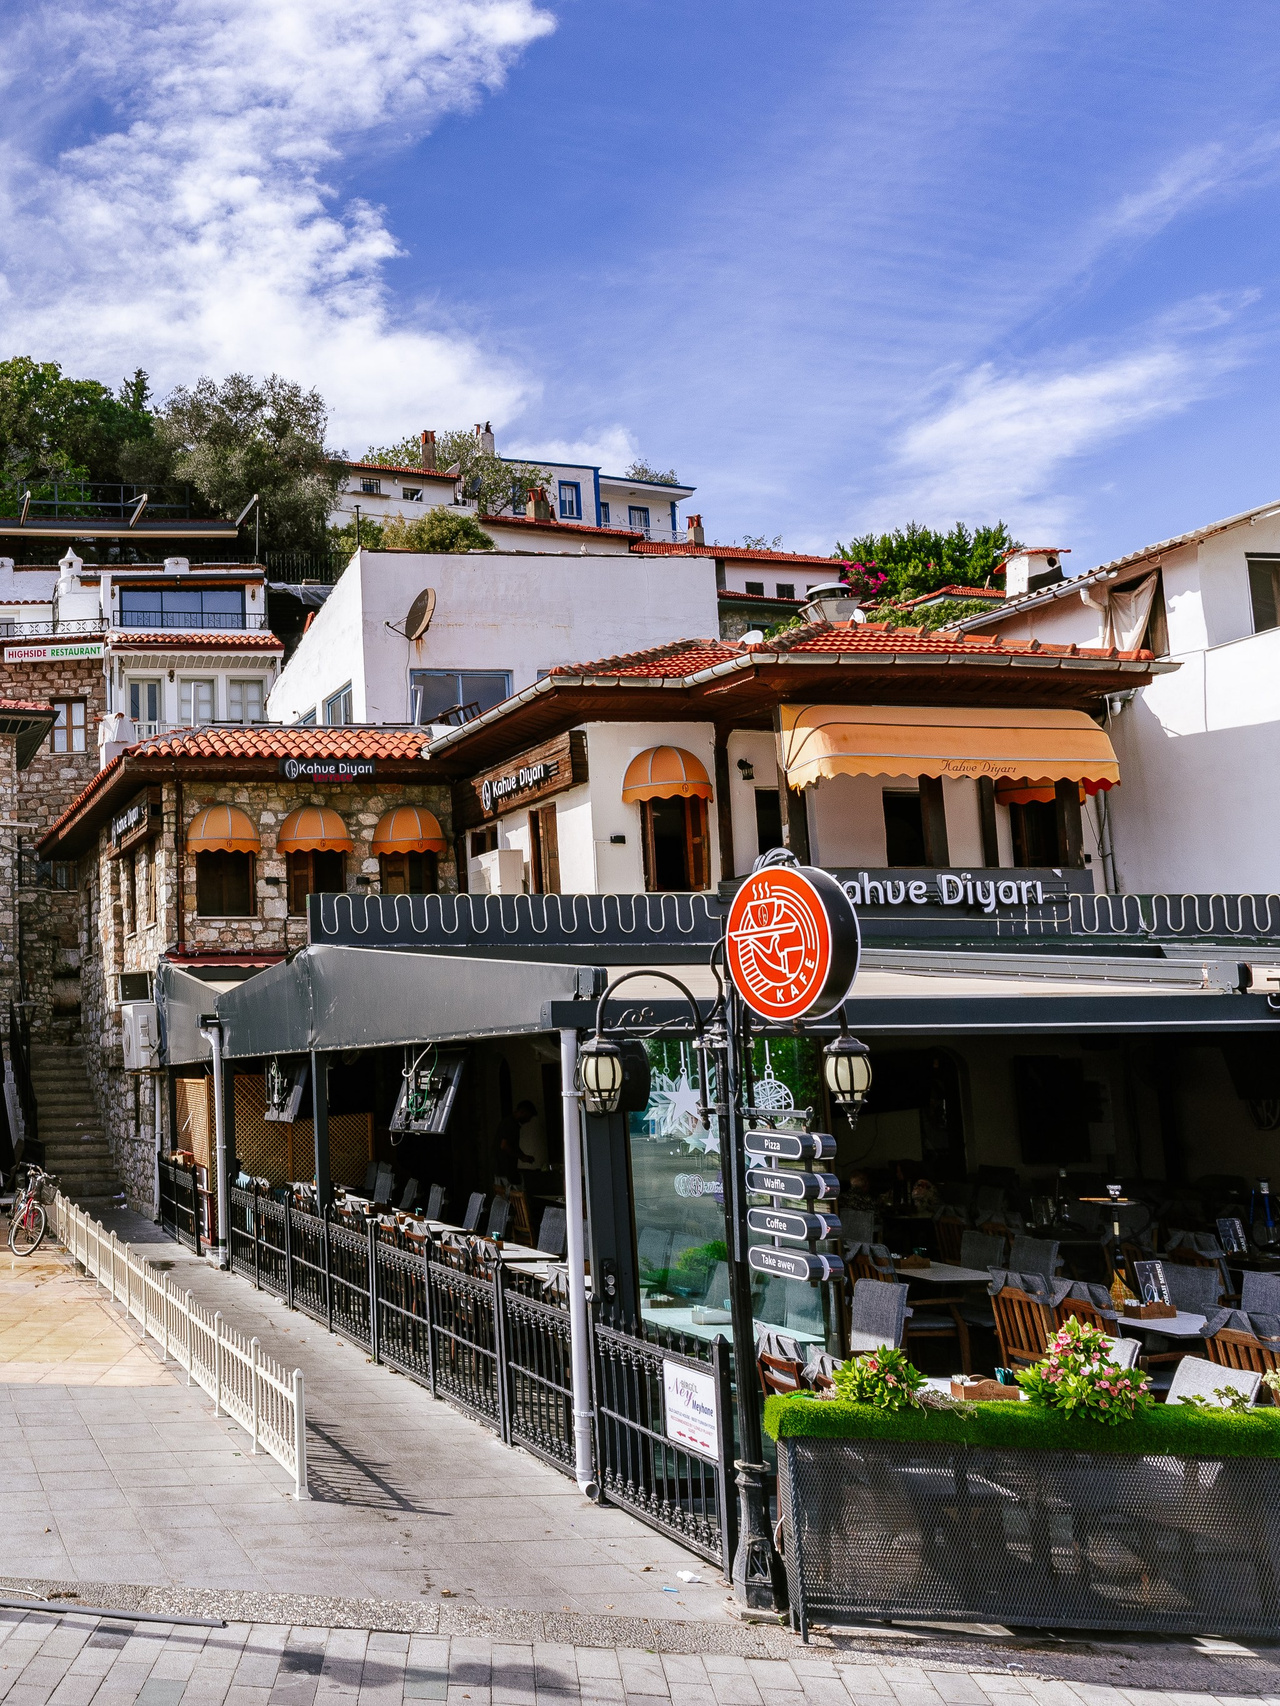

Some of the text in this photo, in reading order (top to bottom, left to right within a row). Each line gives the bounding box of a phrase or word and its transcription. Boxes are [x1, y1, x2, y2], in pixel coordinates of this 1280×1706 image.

[8, 646, 101, 659] HIGHSIDE RESTAURANT
[300, 763, 373, 776] Kahve Diyarı
[939, 760, 977, 772] Kahve
[312, 773, 354, 782] terrace
[492, 764, 544, 798] Kahve Diyarı
[832, 872, 1044, 914] ahve Diyarı
[776, 957, 815, 1002] KAFE
[764, 1139, 781, 1150] Pizza
[763, 1177, 785, 1190] Waffle
[765, 1217, 787, 1231] Coffee
[761, 1254, 777, 1266] Take
[1155, 1263, 1165, 1284] MENU
[669, 1378, 693, 1406] Ney
[692, 1399, 714, 1417] Meyhane
